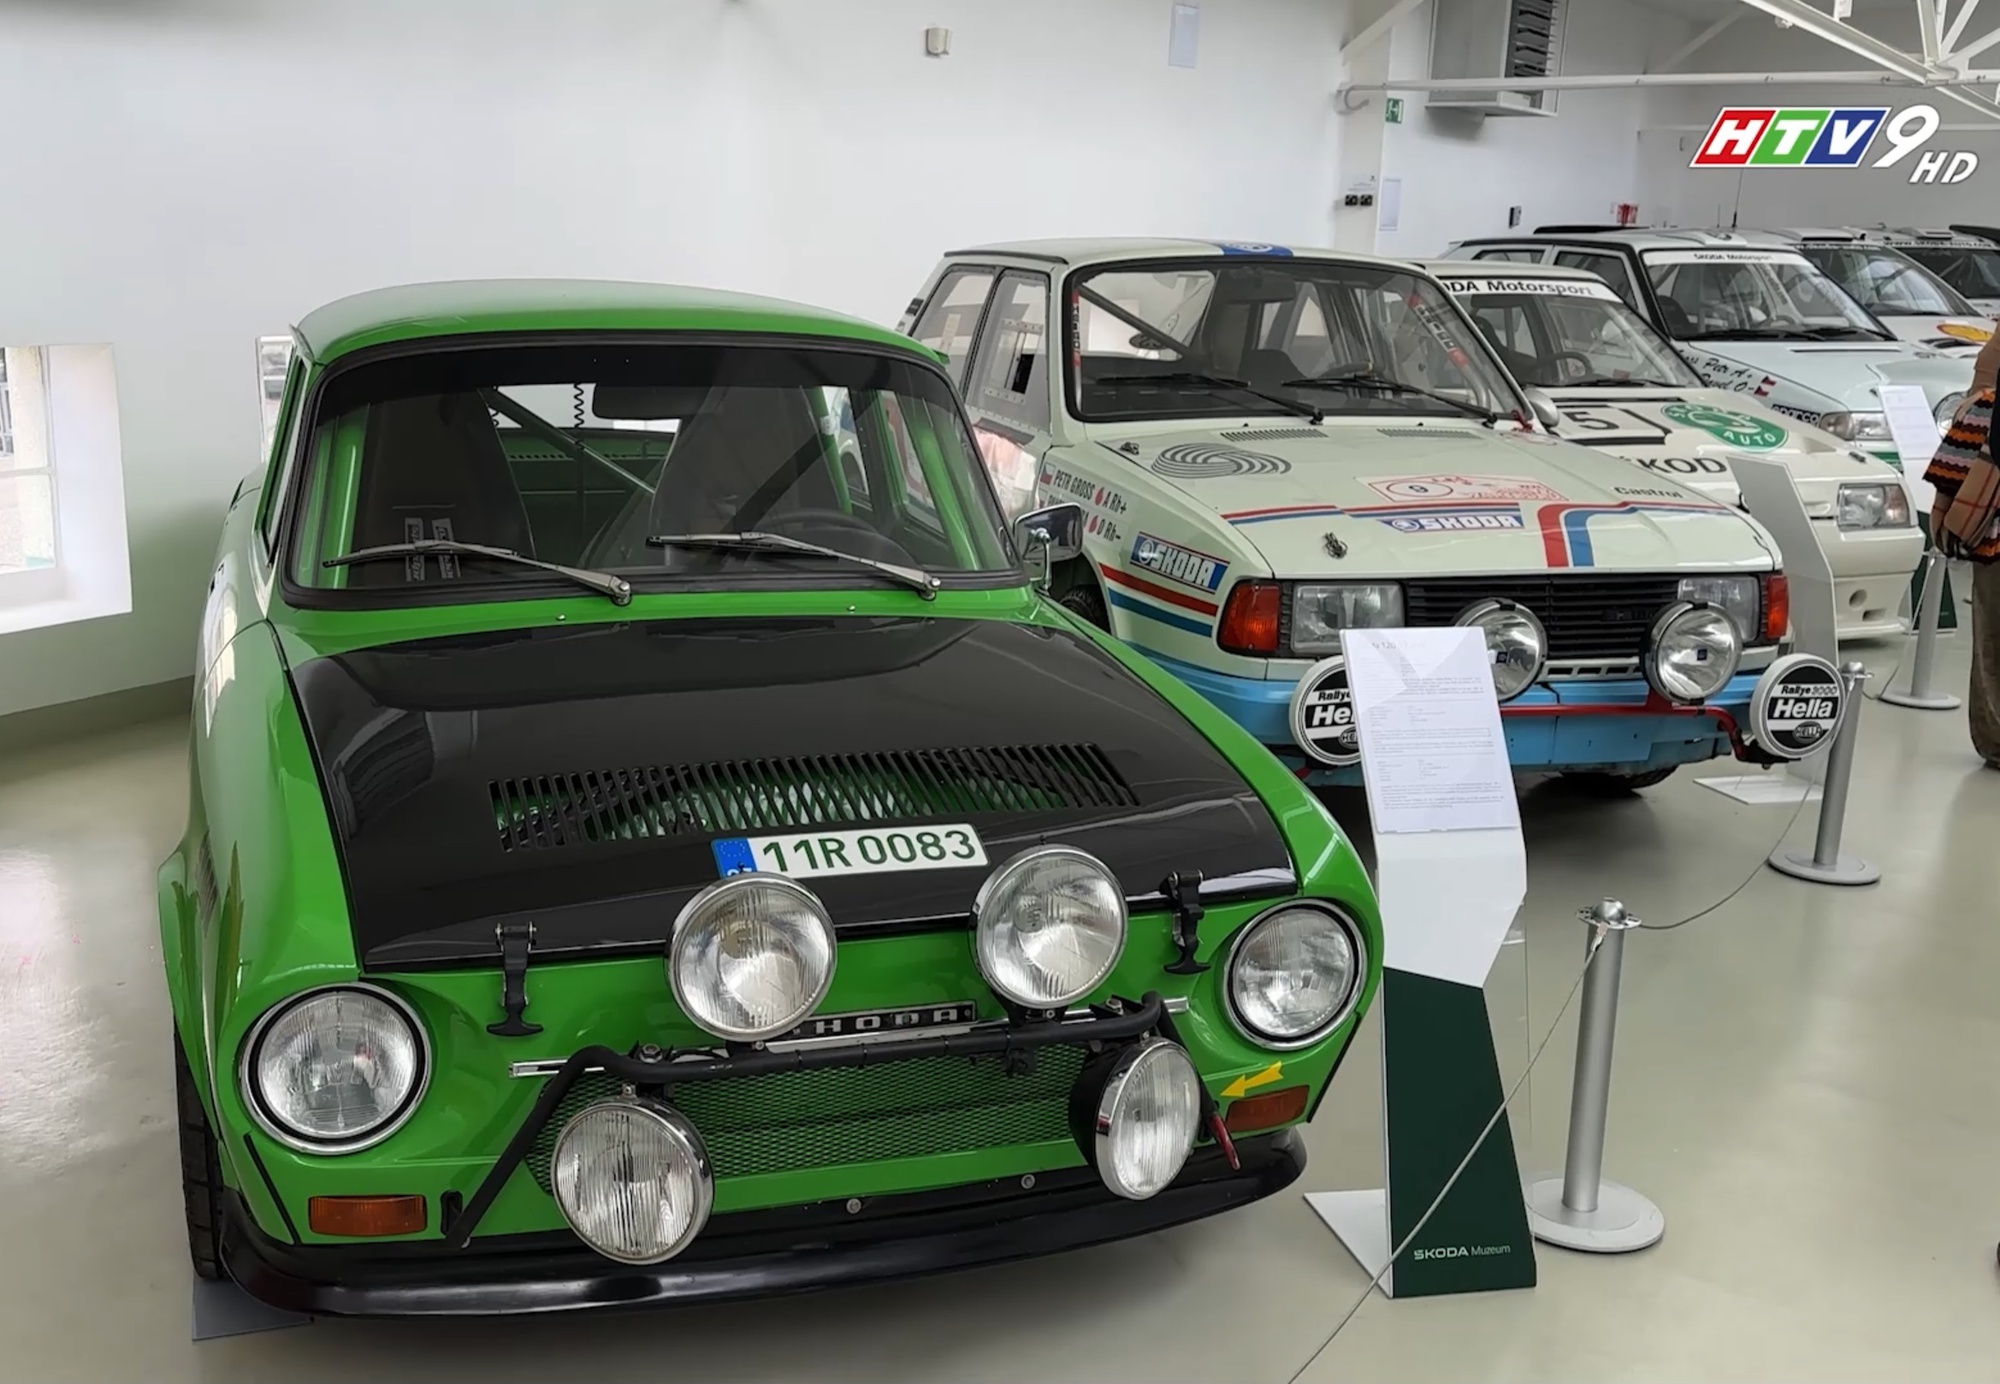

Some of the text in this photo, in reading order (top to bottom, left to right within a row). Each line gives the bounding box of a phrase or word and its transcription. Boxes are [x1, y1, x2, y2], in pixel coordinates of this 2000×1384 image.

[1443, 280, 1595, 296] DA Motorsport
[1723, 428, 1777, 446] AUTO
[1620, 456, 1728, 474] KOD
[1053, 469, 1072, 491] PETR
[1070, 476, 1096, 501] GROSS
[1613, 486, 1684, 499] Castrol
[1419, 516, 1521, 531] SKODA
[1151, 542, 1217, 588] SKODA
[1780, 685, 1811, 697] Rallye
[1773, 698, 1834, 719] Hella
[762, 830, 976, 873] 11R 0083
[1470, 1244, 1512, 1257] Muzeum
